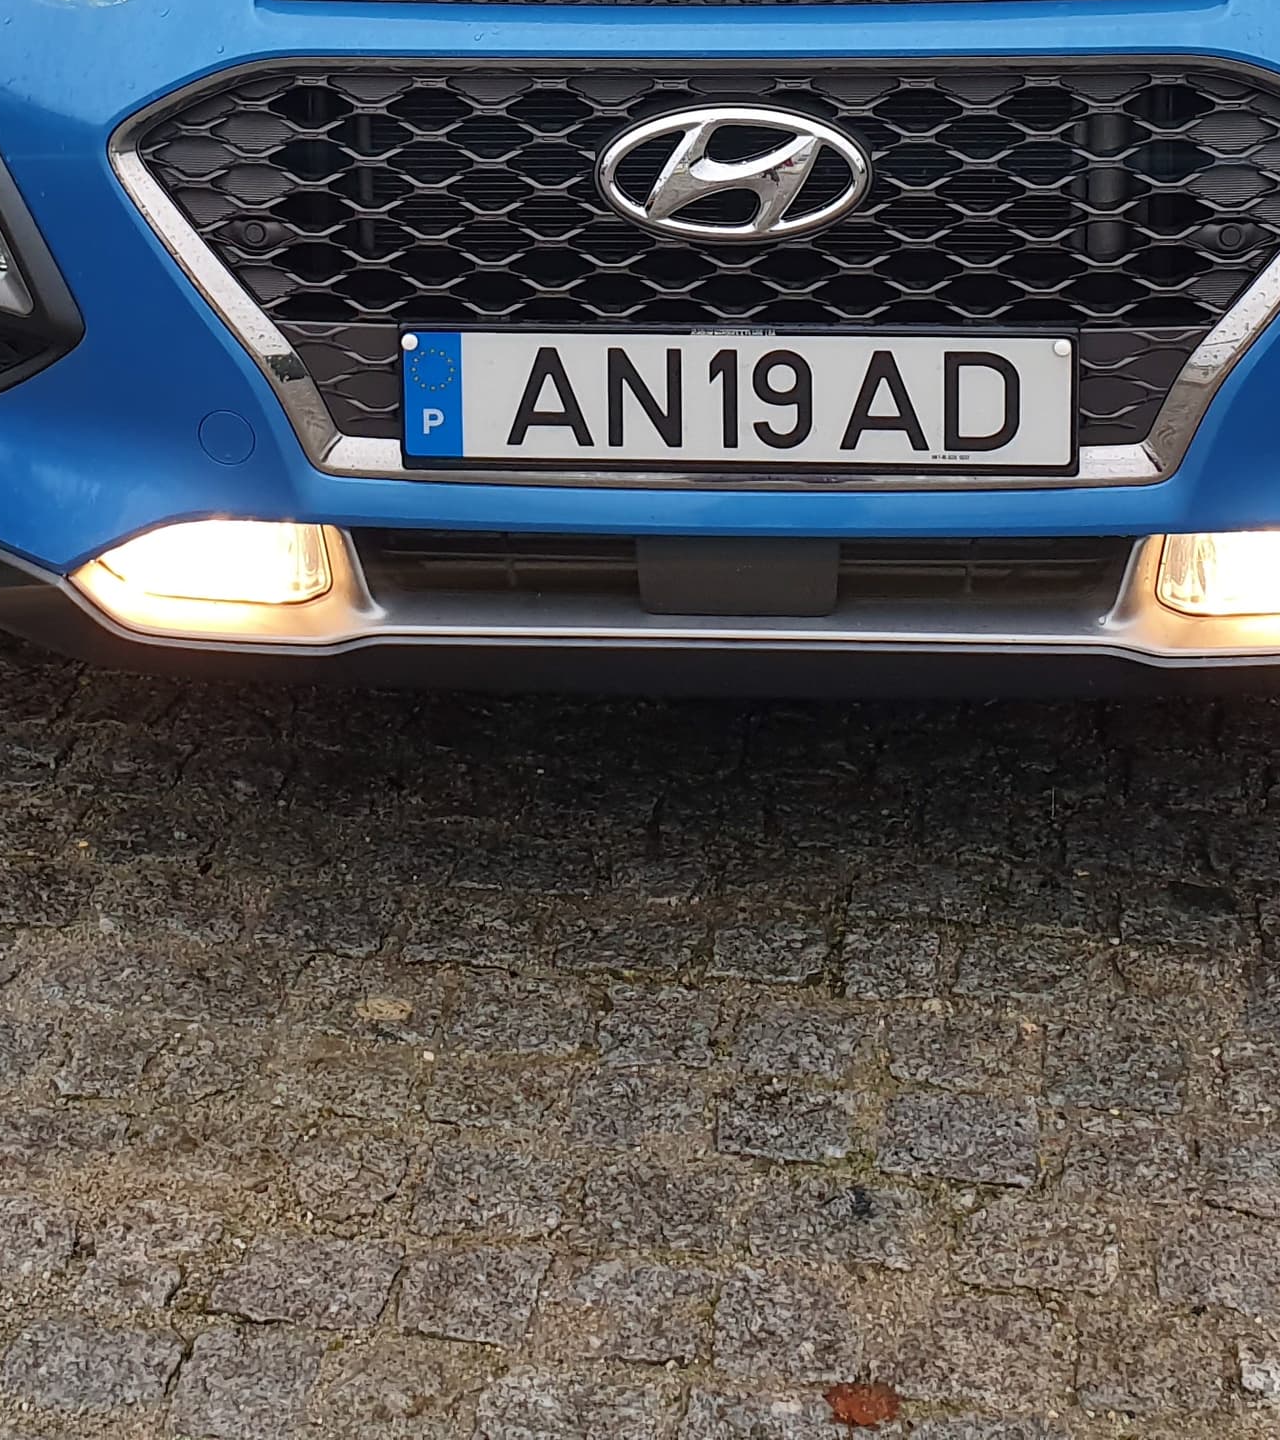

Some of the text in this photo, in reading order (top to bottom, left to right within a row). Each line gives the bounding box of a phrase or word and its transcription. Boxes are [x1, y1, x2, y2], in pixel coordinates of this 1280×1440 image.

[423, 408, 444, 434] P
[507, 346, 1021, 452] AN 19 AD
